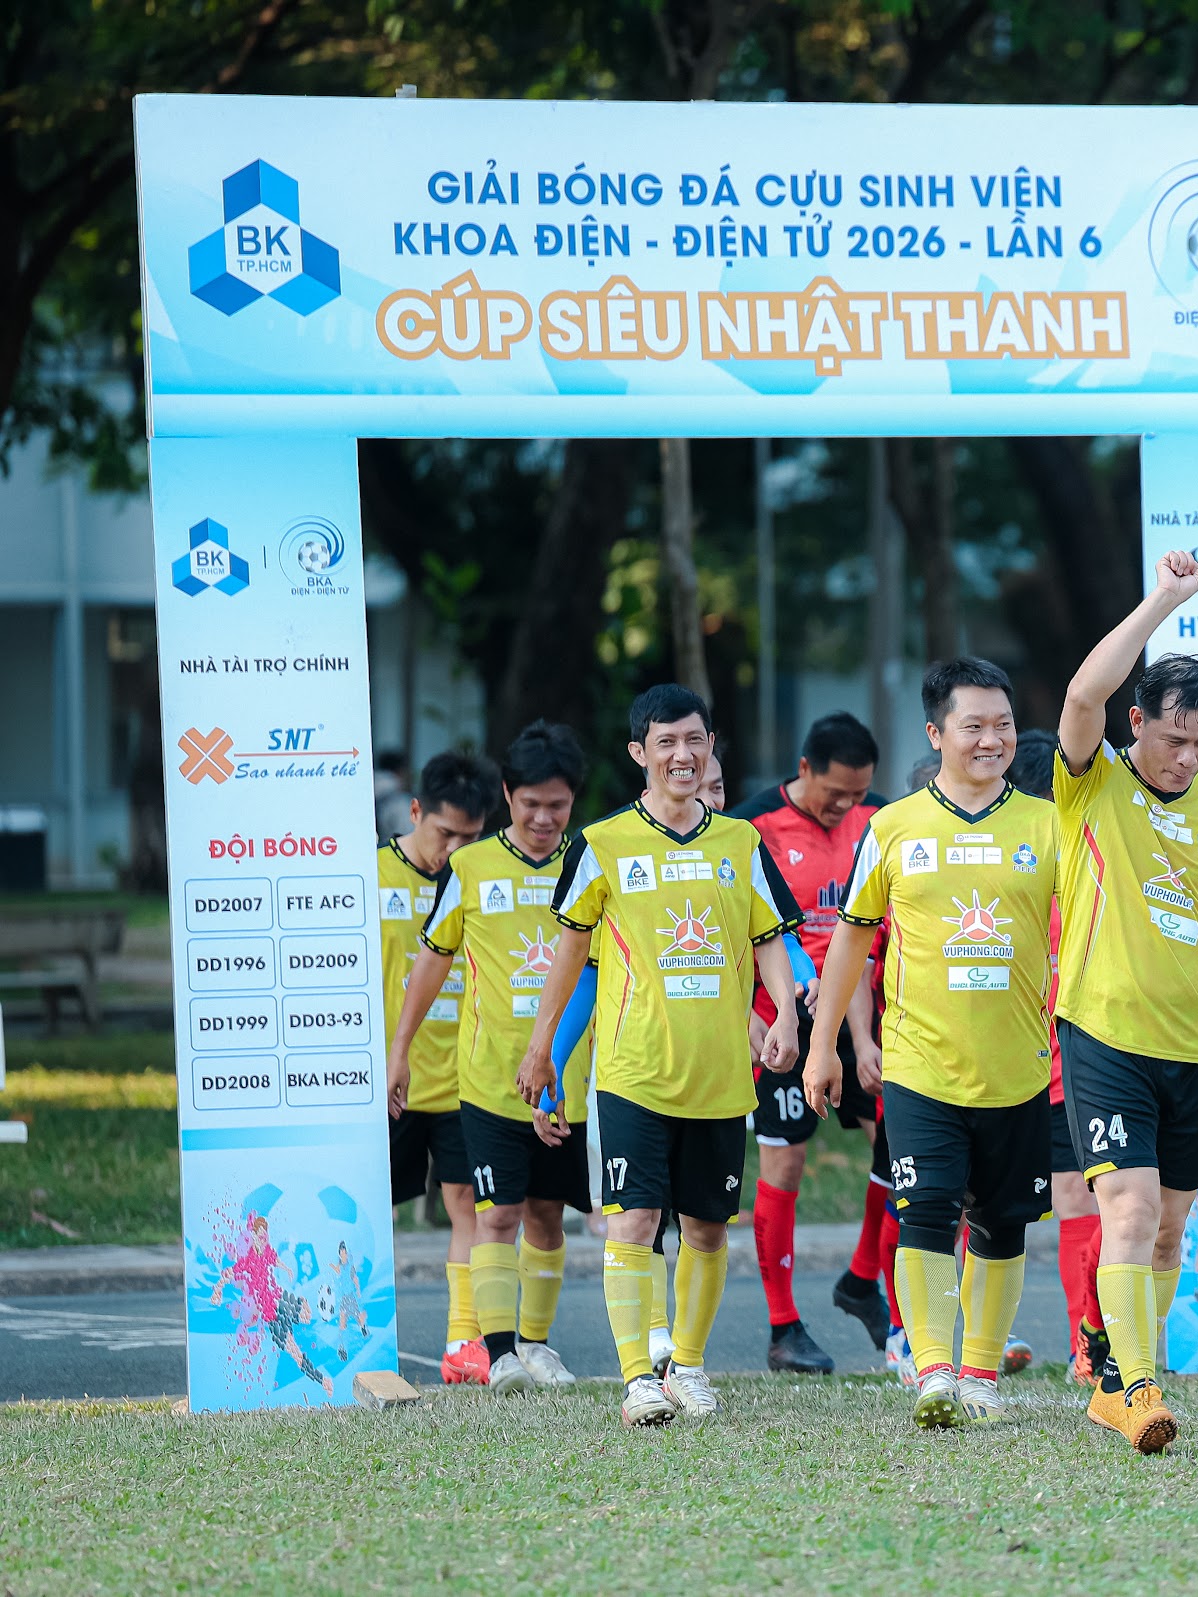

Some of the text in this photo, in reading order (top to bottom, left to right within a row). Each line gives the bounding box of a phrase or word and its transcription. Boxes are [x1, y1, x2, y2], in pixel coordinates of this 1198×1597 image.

[428, 159, 1062, 217] GIẢI BÓNG ĐÁ CỰU SINH VIÊN
[236, 225, 290, 256] BK
[393, 222, 519, 257] KHOA
[535, 215, 630, 267] ĐIỆN
[673, 216, 768, 268] ĐIỆN
[783, 213, 836, 258] TỬ
[847, 225, 946, 258] 2026
[986, 211, 1064, 258] LẦN
[1079, 225, 1102, 258] 6
[236, 259, 292, 273] TP.HCM
[376, 269, 1130, 377] CÚP SIÊU NHẬT THANH
[1151, 511, 1181, 526] NHÀ
[196, 551, 223, 567] BK
[197, 567, 225, 575] TP.HCM
[307, 577, 332, 587] BKA
[180, 653, 349, 676] NHÀ TÀI TRỢ CHÍNH
[268, 728, 315, 750] SNT
[235, 759, 360, 779] Sao nhanh thế
[208, 831, 338, 865] ĐỘI BÓNG
[908, 860, 930, 868] BKE
[627, 878, 649, 887] BKE
[195, 897, 262, 913] DD2007
[287, 894, 355, 910] FTE AFC
[944, 946, 1013, 958] VUPHONG.COM
[196, 956, 266, 972] DD1996
[289, 953, 358, 969] DD2009
[658, 955, 725, 969] VUPHONG.COM
[199, 1015, 268, 1032] DD1999
[289, 1012, 363, 1029] DD03-93
[202, 1075, 271, 1091] DD2008
[287, 1070, 370, 1088] BKA HC2K
[773, 1086, 804, 1121] 16
[1088, 1114, 1128, 1153] 24
[473, 1164, 495, 1197] 11
[606, 1157, 628, 1191] 17
[891, 1156, 918, 1190] 25
